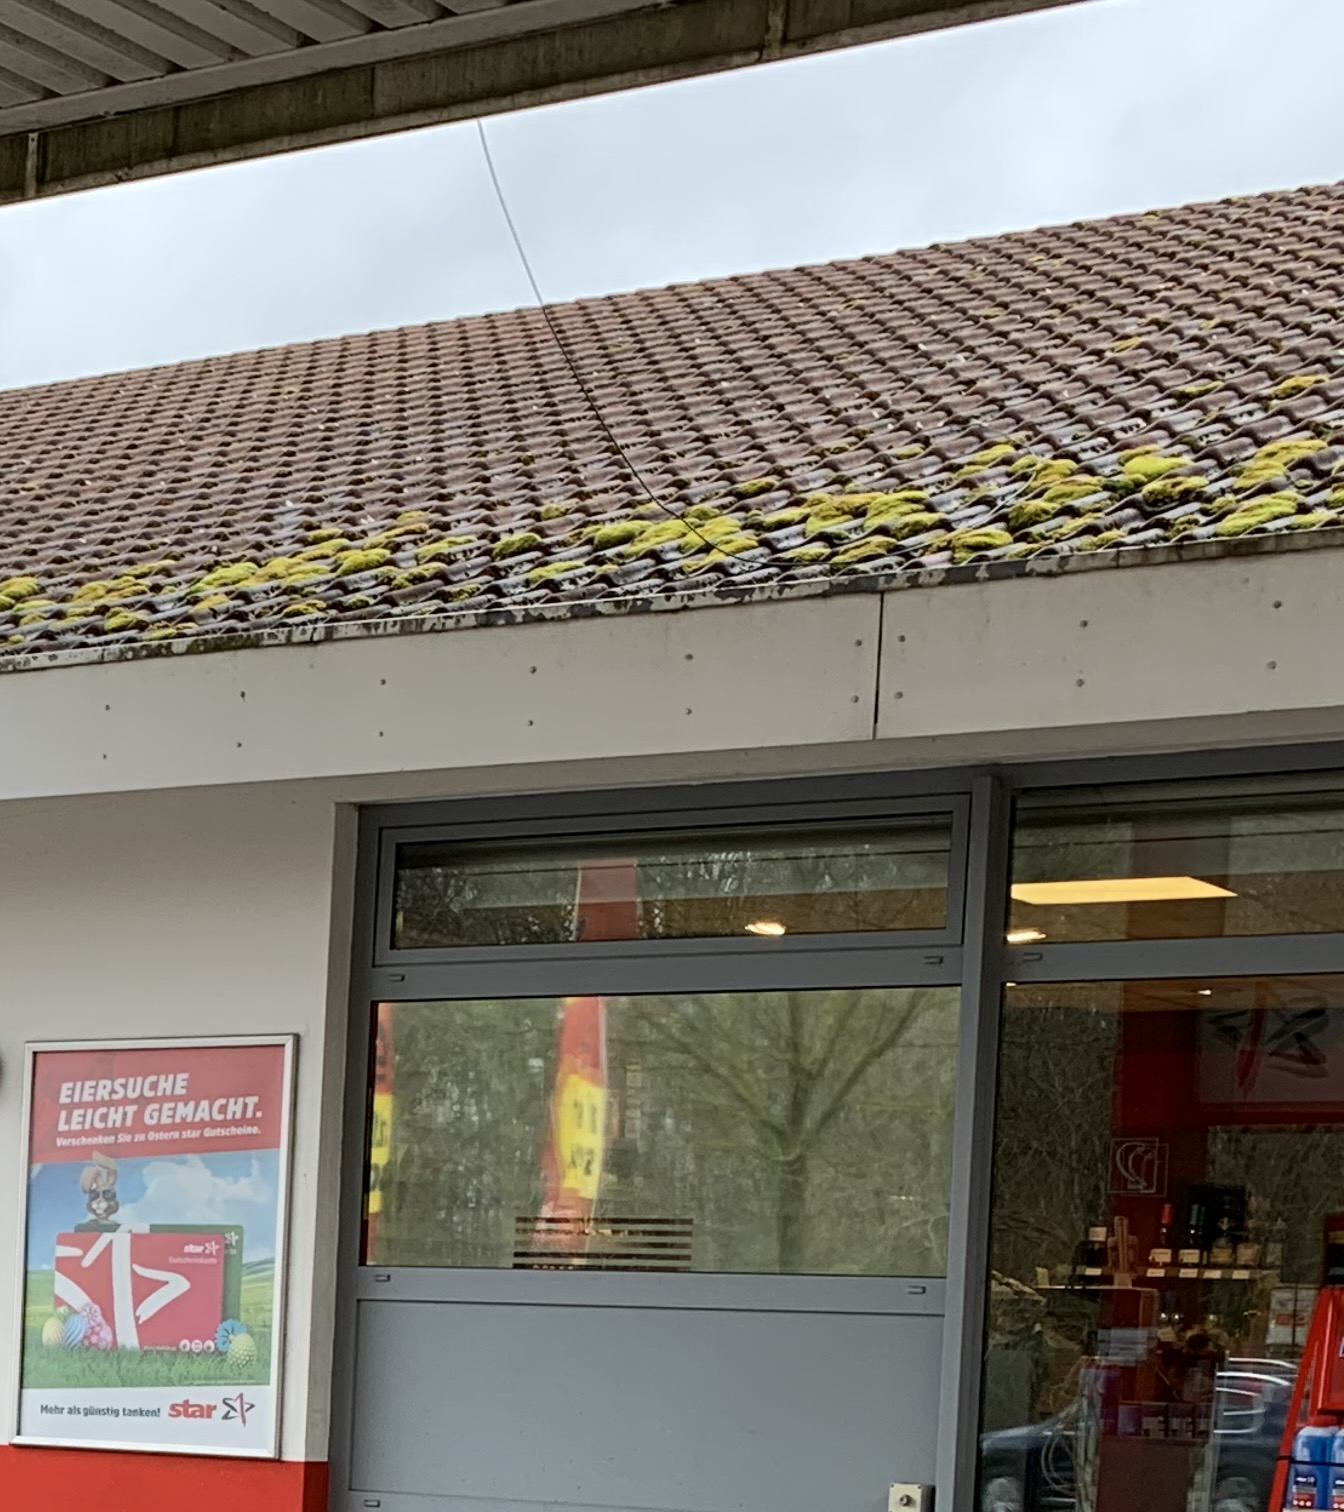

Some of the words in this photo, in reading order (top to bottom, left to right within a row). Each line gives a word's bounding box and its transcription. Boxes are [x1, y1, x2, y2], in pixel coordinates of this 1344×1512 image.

[59, 1073, 189, 1104] EIERSUCHE
[57, 1105, 138, 1132] LEICHT
[144, 1095, 263, 1125] GEMACHT.
[56, 1135, 115, 1147] Verschenken
[117, 1133, 132, 1143] Sie
[134, 1134, 146, 1142] zu
[147, 1130, 179, 1141] Ostern
[182, 1129, 201, 1139] star
[203, 1125, 261, 1137] Gutscheine.
[40, 1405, 65, 1415] Mehr
[67, 1405, 81, 1416] als
[83, 1406, 120, 1418] günstig
[122, 1407, 161, 1418] tanken!
[168, 1399, 217, 1419] star
